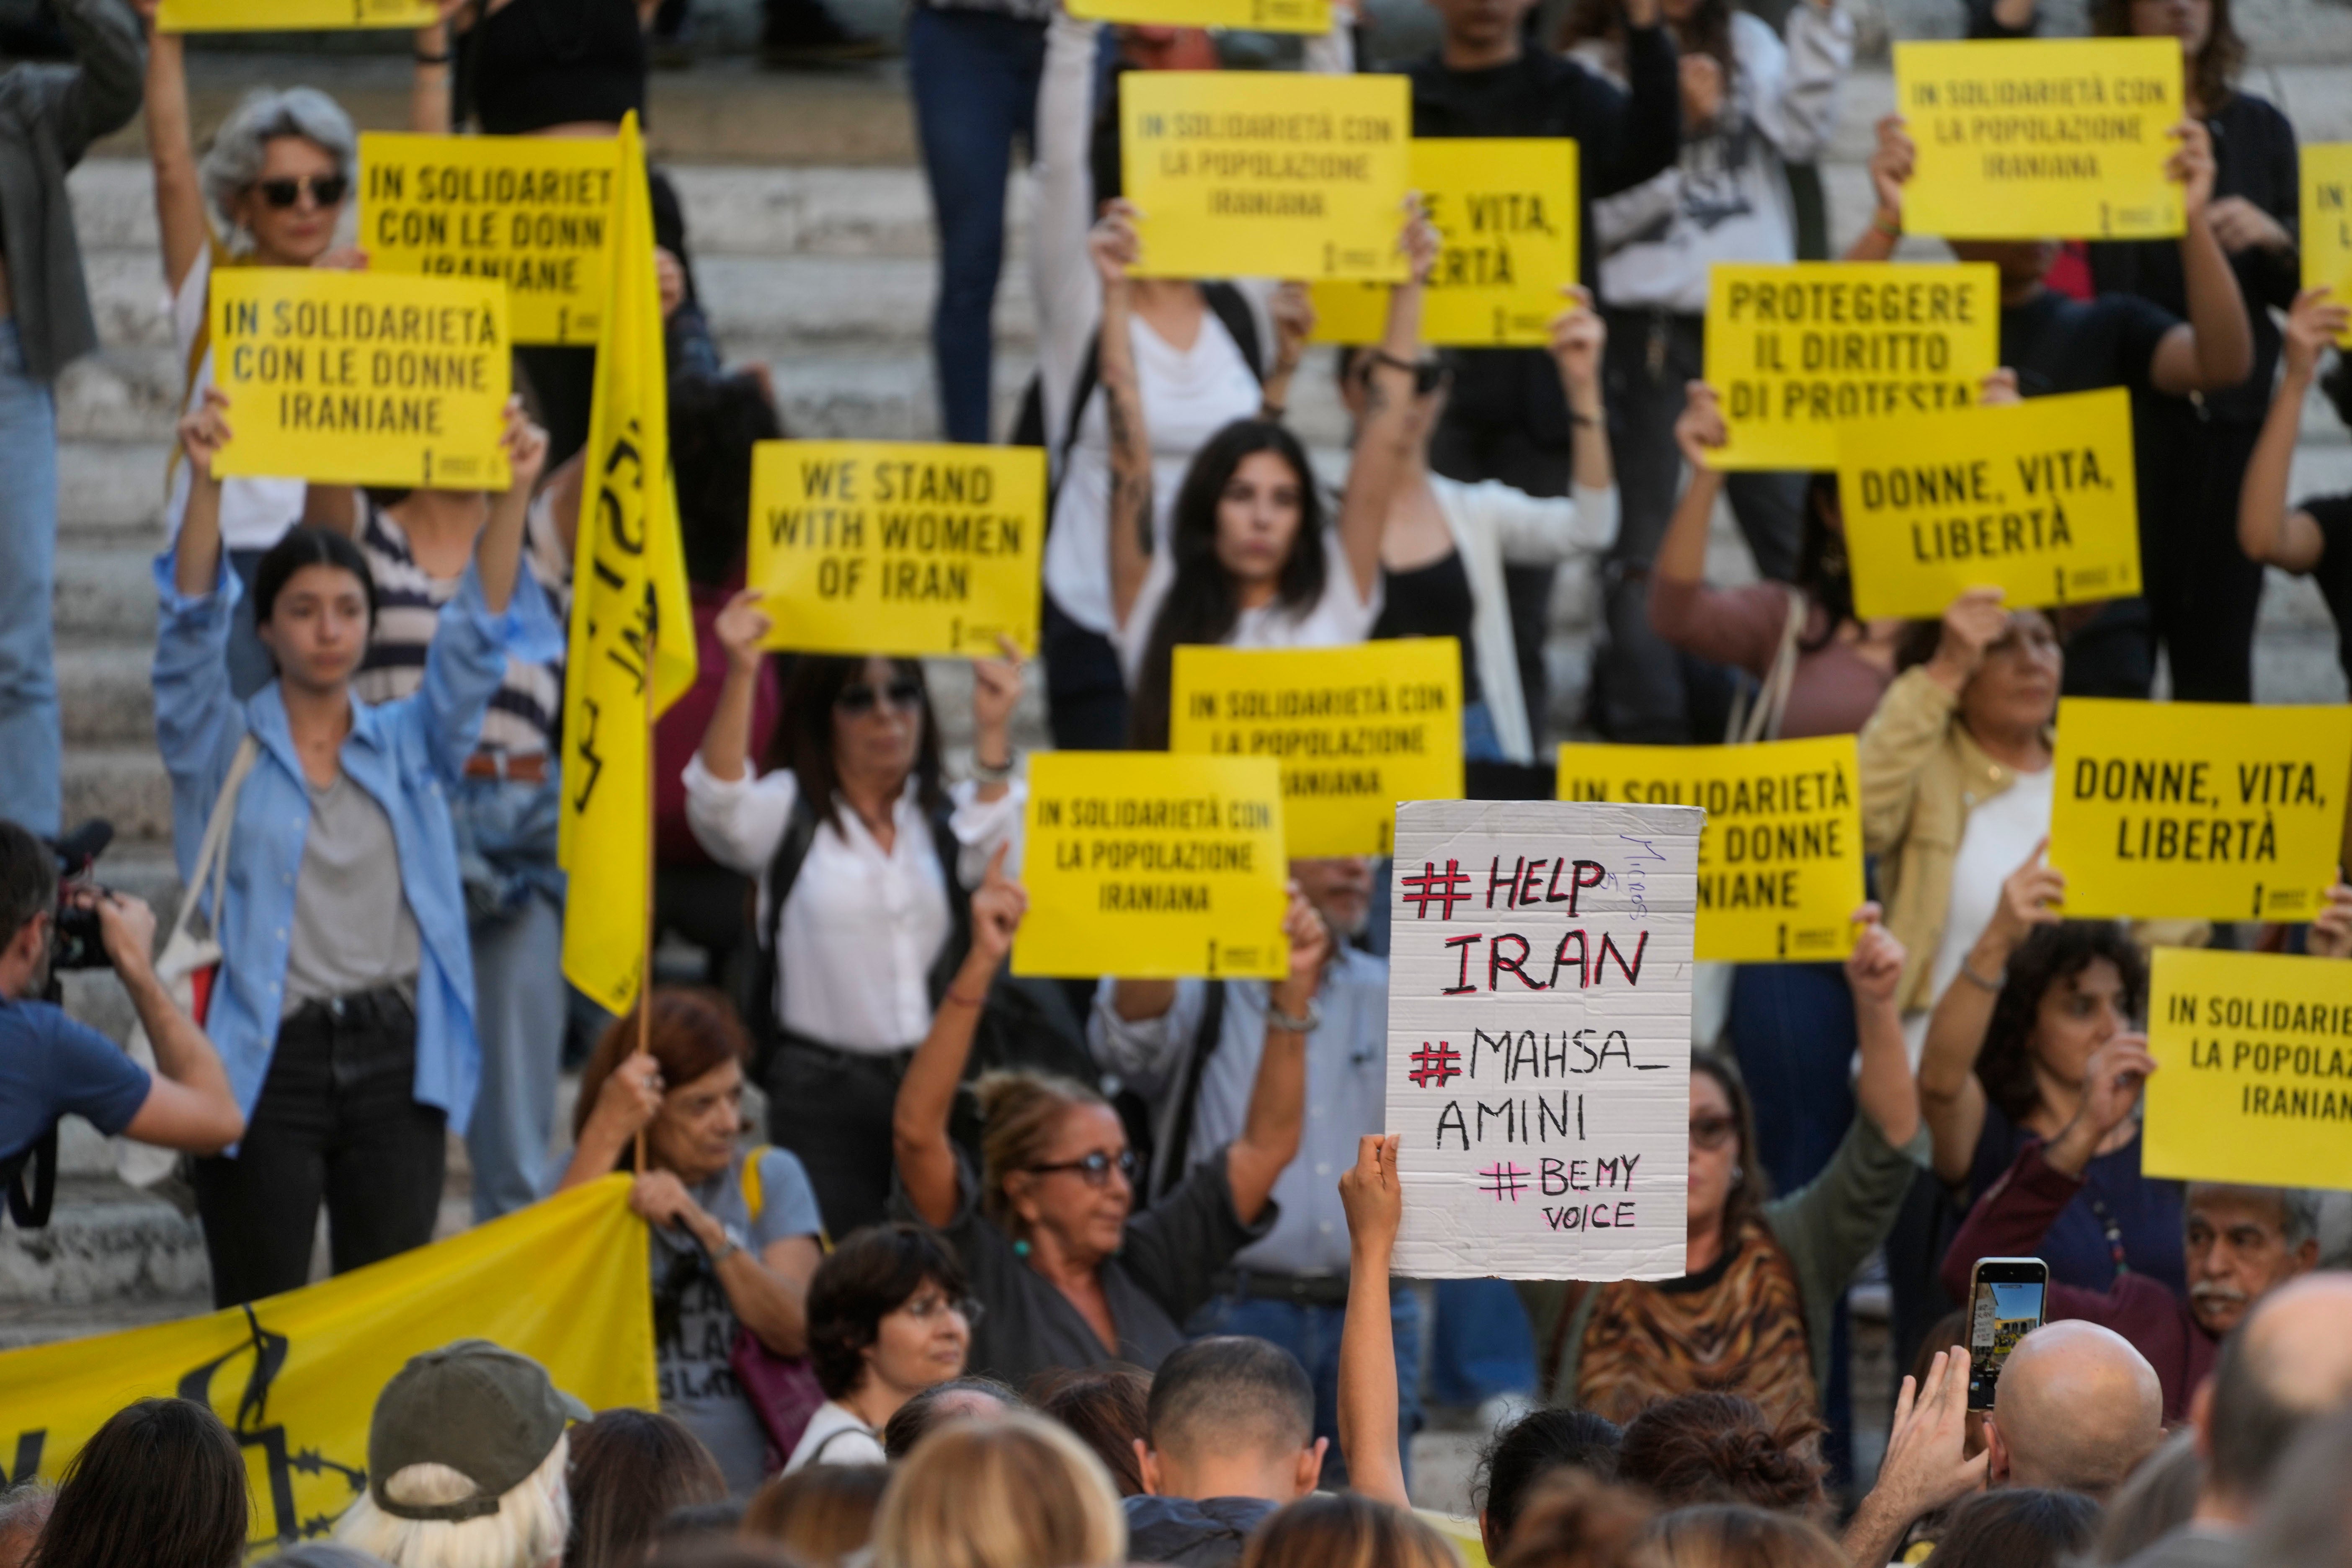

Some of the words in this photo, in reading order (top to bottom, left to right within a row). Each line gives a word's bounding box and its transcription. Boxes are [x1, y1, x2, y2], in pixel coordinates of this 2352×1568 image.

[1912, 82, 1938, 106] IN
[1945, 72, 2105, 106] SOLIDARIETÀ
[2115, 77, 2166, 103] CON
[1137, 113, 1165, 138] IN
[1343, 117, 1393, 142] CON
[1934, 118, 1964, 144] LA
[1973, 115, 2141, 144] POPOLAZIONE
[369, 165, 403, 200] IN
[418, 166, 613, 204] SOLIDARIET
[1161, 150, 1188, 176] LA
[1198, 150, 1371, 182] POPOLAZIONE
[1983, 153, 2100, 180] IRANIANA
[2317, 183, 2343, 211] IN
[379, 209, 448, 247] CON
[461, 212, 498, 248] LE
[512, 213, 606, 249] DONN
[1728, 281, 1974, 323] PROTEGGERE
[224, 300, 258, 335] IN
[273, 300, 498, 346] SOLIDARIETÀ
[235, 346, 304, 382] CON
[319, 348, 356, 385] LE
[372, 351, 487, 391] DONNE
[1756, 333, 1785, 369] IL
[1803, 333, 1949, 372] DIRITTO
[279, 392, 443, 434] IRANIANE
[1730, 380, 1769, 419] DI
[800, 460, 856, 501] WE
[873, 462, 993, 505] STAND
[1860, 460, 2006, 511] DONNE,
[2017, 446, 2113, 495] VITA,
[768, 507, 864, 548] WITH
[881, 513, 1024, 556] WOMEN
[1912, 496, 2072, 563] LIBERTÀ
[818, 557, 864, 598] OF
[882, 560, 970, 601] IRAN
[1190, 691, 1215, 719] IN
[1226, 679, 1389, 720] SOLIDARIETÀ
[1398, 683, 1446, 711] CON
[1211, 730, 1241, 753] LA
[1251, 724, 1424, 755] POPOLAZIONE
[1282, 769, 1381, 797] ANIANA
[2074, 758, 2219, 810] DONNE,
[2238, 761, 2326, 810] VITA,
[1038, 799, 1062, 830] IN
[1070, 793, 1219, 830] SOLIDARIETÀ
[1228, 799, 1271, 830] CON
[1726, 820, 1843, 863] DONNE
[2117, 807, 2277, 862] LIBERTÀ
[1056, 842, 1082, 871] LA
[1091, 841, 1253, 872] POPOLAZIONE
[1099, 883, 1211, 912] IRANIANA
[1697, 869, 1800, 910] NIANE
[1440, 929, 1648, 994] IRAN
[2168, 994, 2197, 1023] IN
[2191, 1038, 2221, 1068] LA
[1437, 1090, 1585, 1151] AMINI
[1540, 1201, 1636, 1232] VOICE
